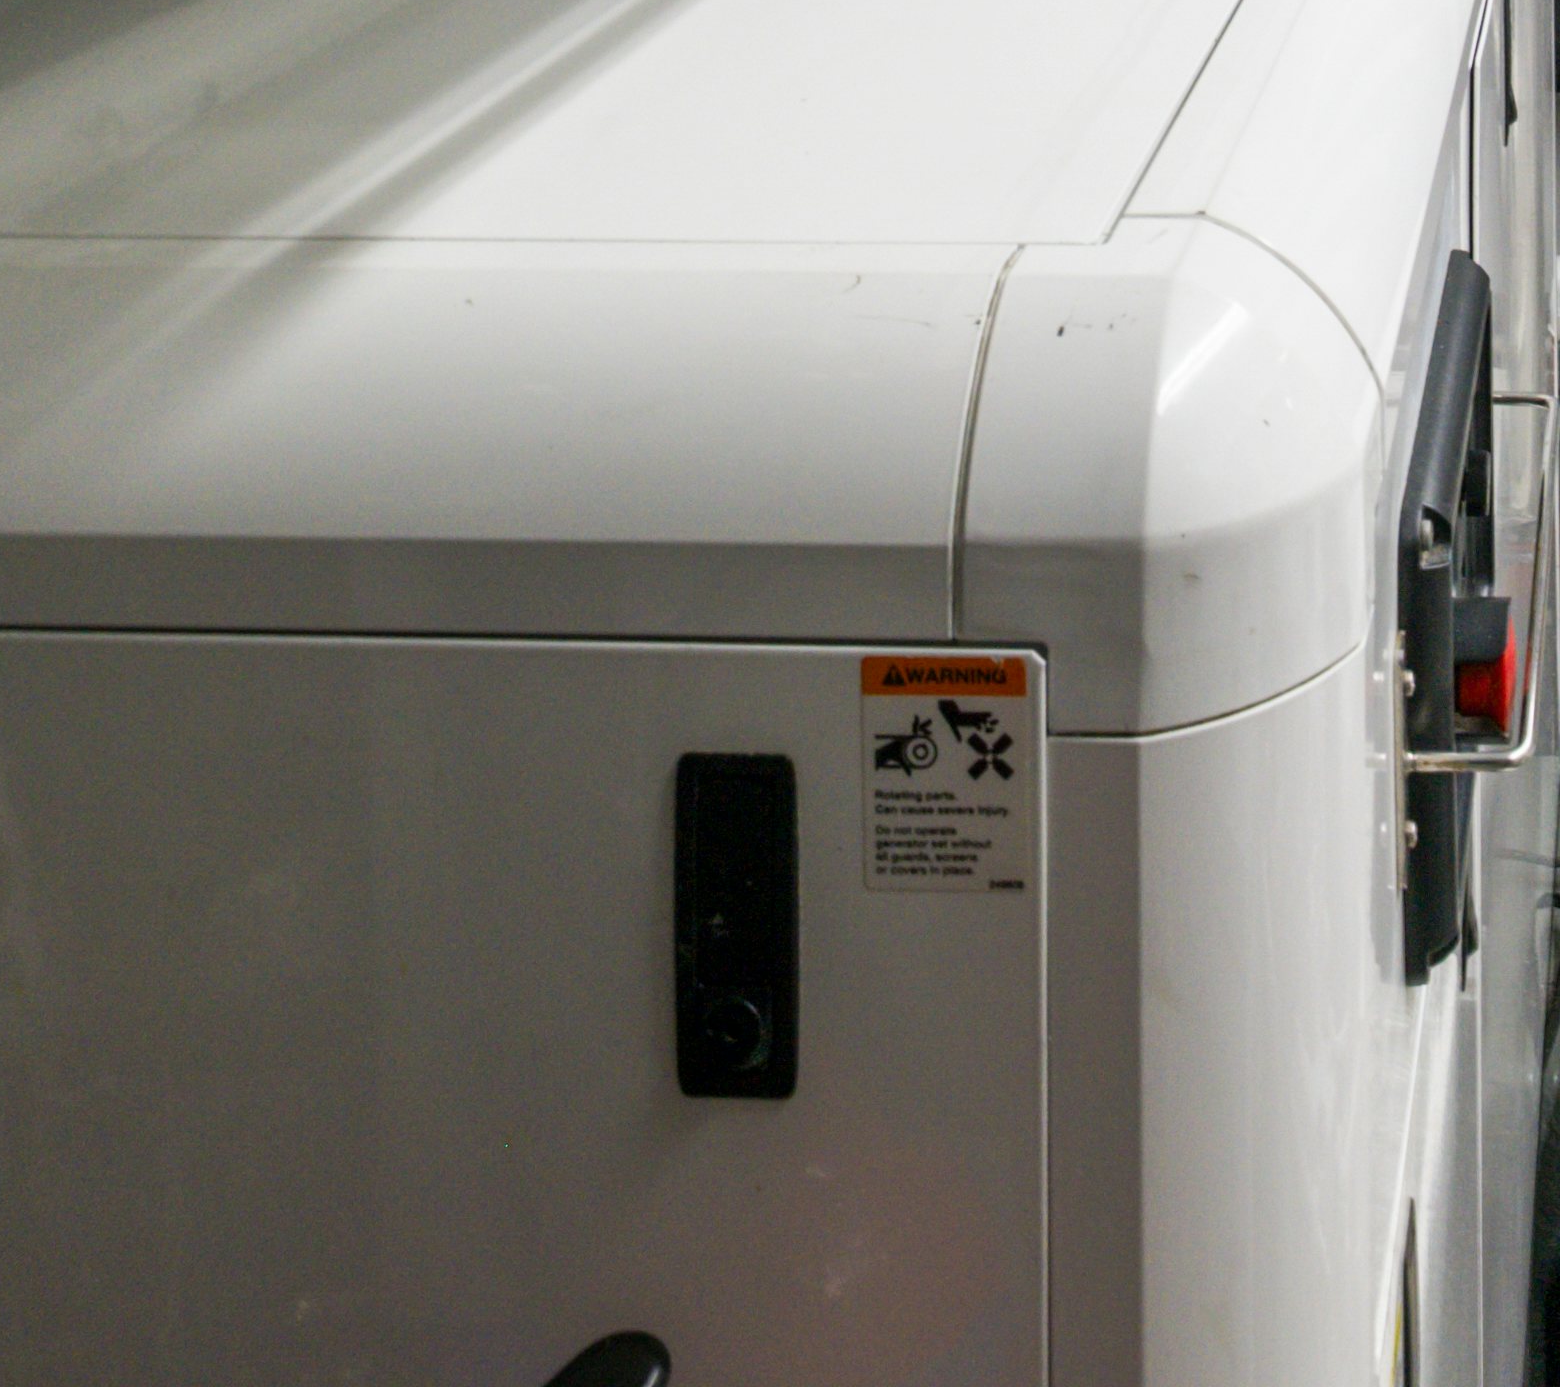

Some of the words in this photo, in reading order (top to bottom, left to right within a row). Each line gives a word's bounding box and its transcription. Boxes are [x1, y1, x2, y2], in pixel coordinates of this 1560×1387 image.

[905, 666, 1007, 685] WARNING
[875, 790, 922, 802] Rotating
[875, 805, 897, 815] Can
[901, 806, 934, 815] cause
[937, 806, 974, 815] severe
[875, 825, 891, 835] Do
[894, 826, 912, 835] not
[915, 826, 957, 838] operate
[875, 840, 928, 852] generator
[931, 840, 949, 850] set
[952, 839, 992, 849] without
[875, 852, 889, 862] all
[935, 853, 977, 863] screens
[875, 867, 887, 875] or
[890, 866, 927, 875] covers
[930, 865, 940, 874] in
